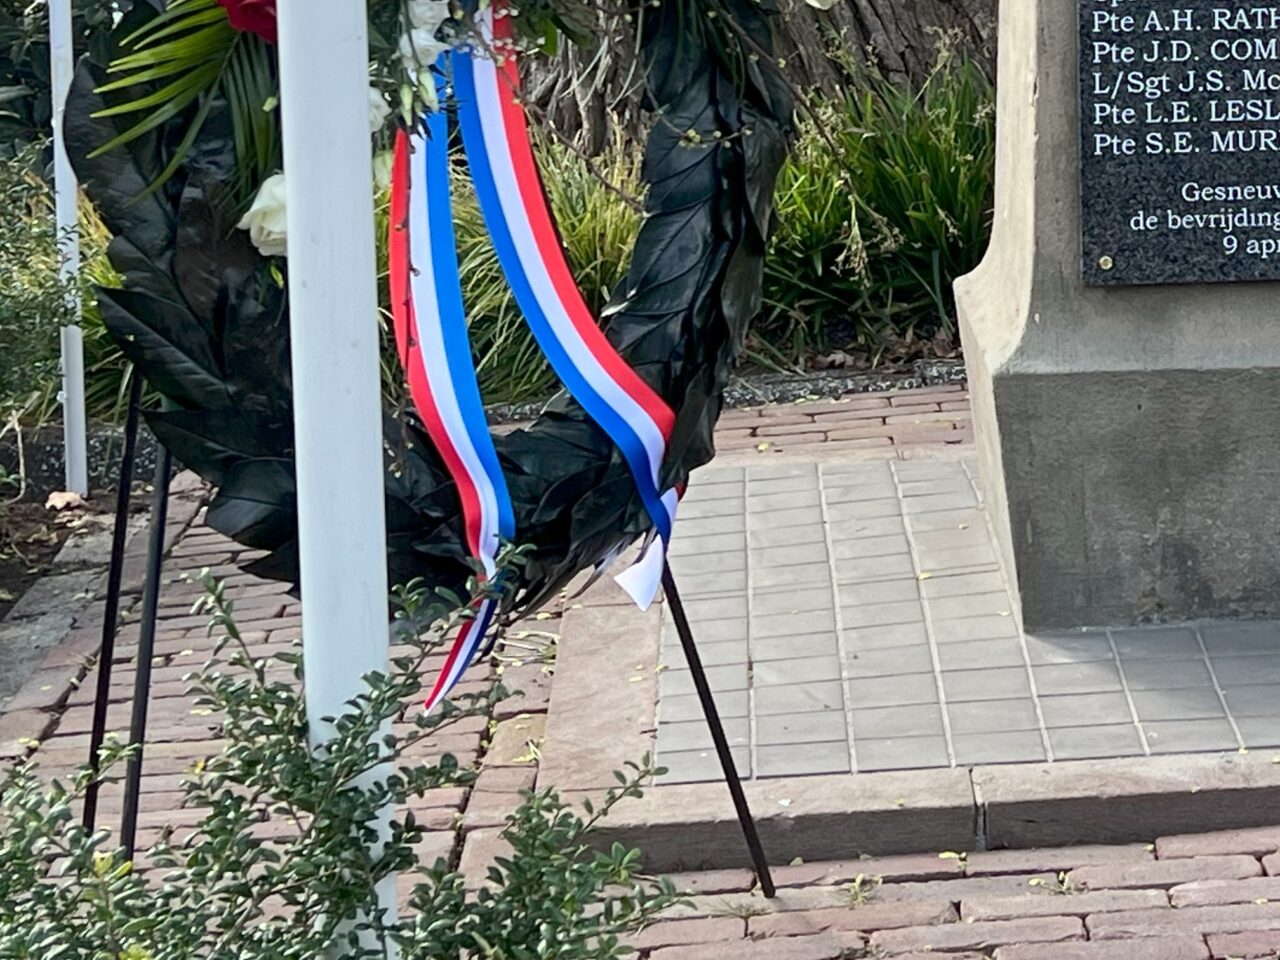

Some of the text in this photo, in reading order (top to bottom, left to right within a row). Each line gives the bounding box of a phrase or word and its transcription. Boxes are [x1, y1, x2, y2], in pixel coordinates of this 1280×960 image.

[1092, 10, 1135, 33] Pte
[1143, 9, 1201, 32] A.H.
[1092, 41, 1135, 63] Pte
[1143, 40, 1200, 63] J.D.
[1092, 70, 1171, 100] L/Sgt
[1178, 69, 1231, 92] J.S.
[1093, 103, 1136, 125] Pte
[1145, 101, 1198, 123] L.E.
[1093, 133, 1136, 156] Pte
[1145, 131, 1200, 154] S.E.
[1130, 210, 1158, 231] de
[1223, 235, 1238, 255] 9
